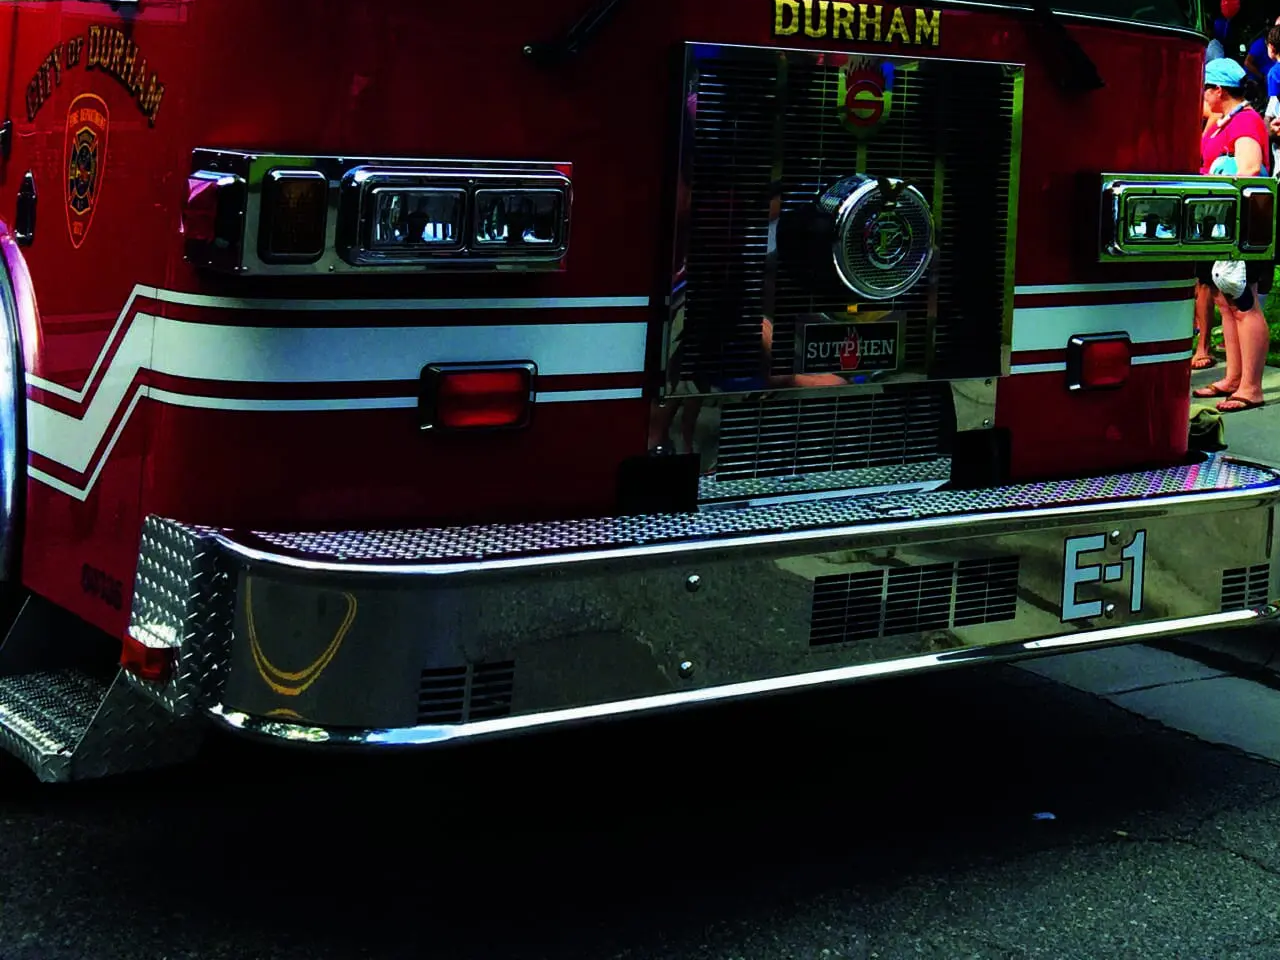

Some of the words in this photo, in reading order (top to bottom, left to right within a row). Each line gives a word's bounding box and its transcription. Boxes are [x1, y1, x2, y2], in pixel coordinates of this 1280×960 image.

[26, 42, 65, 122] CITY
[67, 37, 84, 70] OF
[86, 24, 165, 128] DURHAM
[806, 339, 895, 359] SUTPHEN
[1060, 529, 1147, 623] E-1
